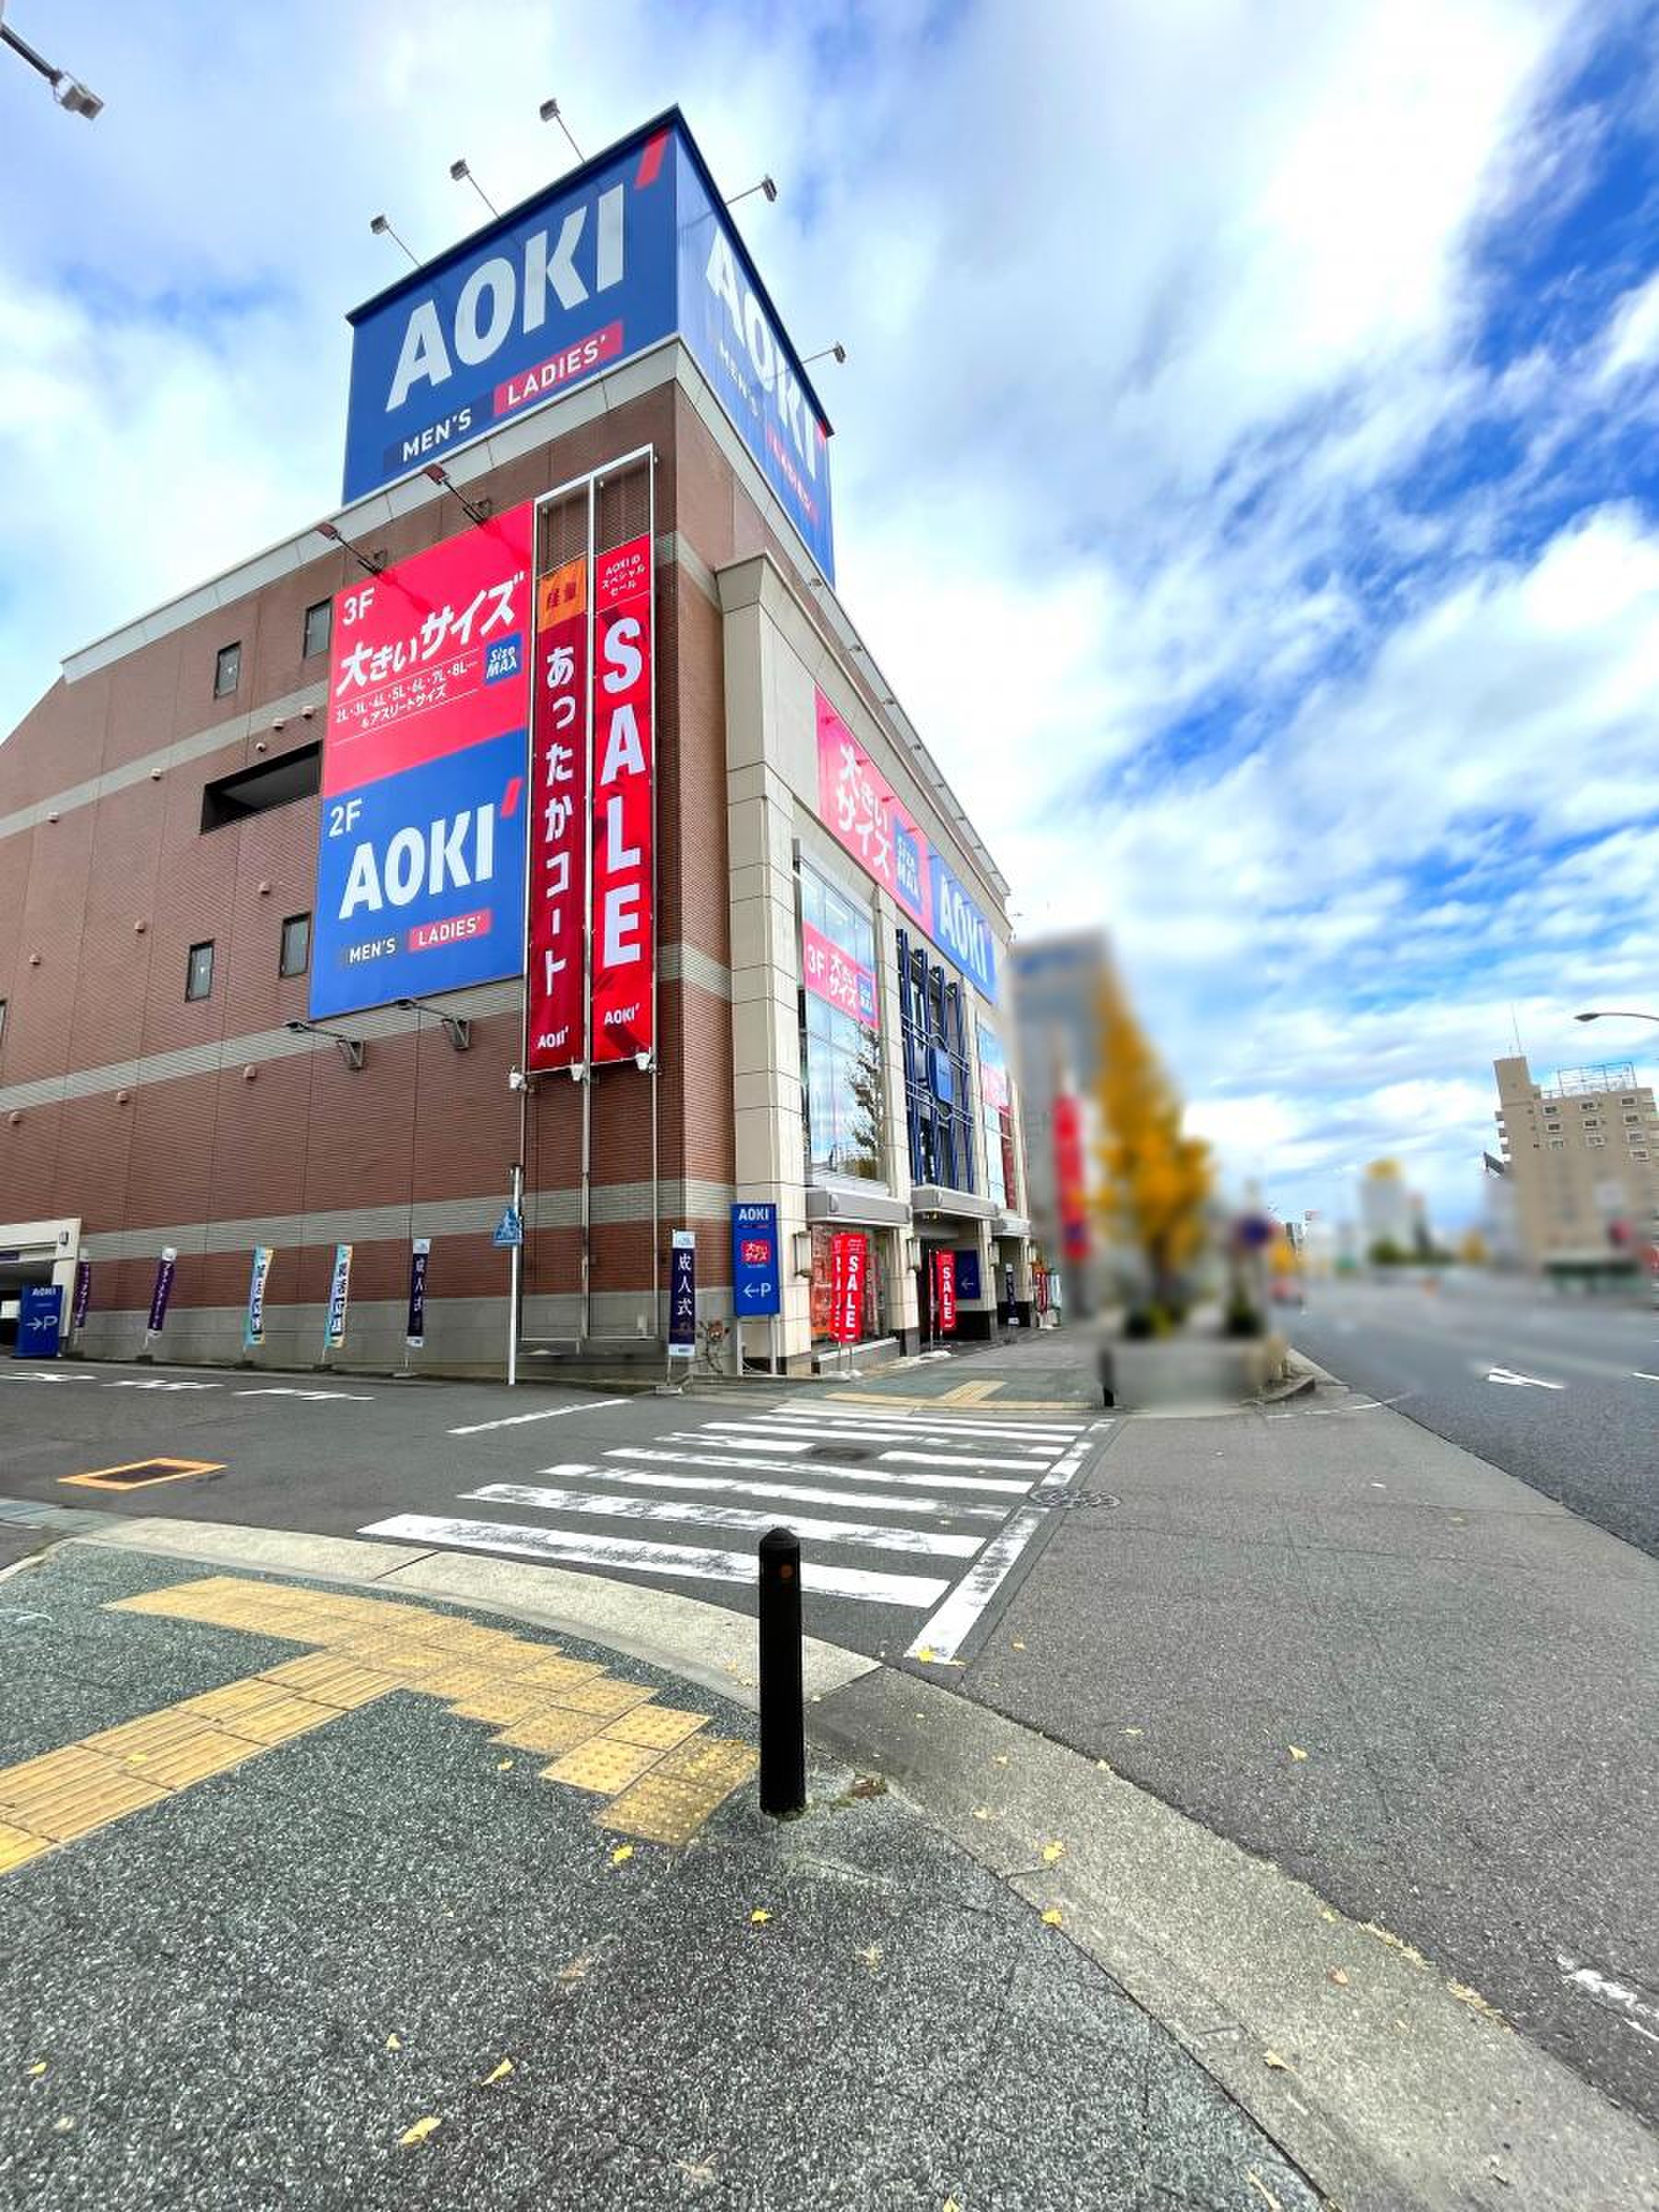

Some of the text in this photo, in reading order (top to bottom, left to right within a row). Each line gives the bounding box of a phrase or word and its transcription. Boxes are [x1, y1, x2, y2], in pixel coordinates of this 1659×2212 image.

[402, 334, 606, 463] MEN'S LADIES'
[342, 588, 375, 626] 3F
[336, 571, 524, 697] 大きいサイズ
[329, 798, 362, 838] 2F
[600, 617, 646, 969] SALE
[545, 645, 575, 996] あったかコート
[348, 937, 397, 964] MEN'S
[738, 1209, 769, 1221] AOKI
[677, 1253, 693, 1316] 成人式
[760, 1283, 771, 1298] P
[845, 1255, 859, 1328] SALE
[943, 1267, 952, 1320] SALE
[43, 1315, 58, 1330] P
